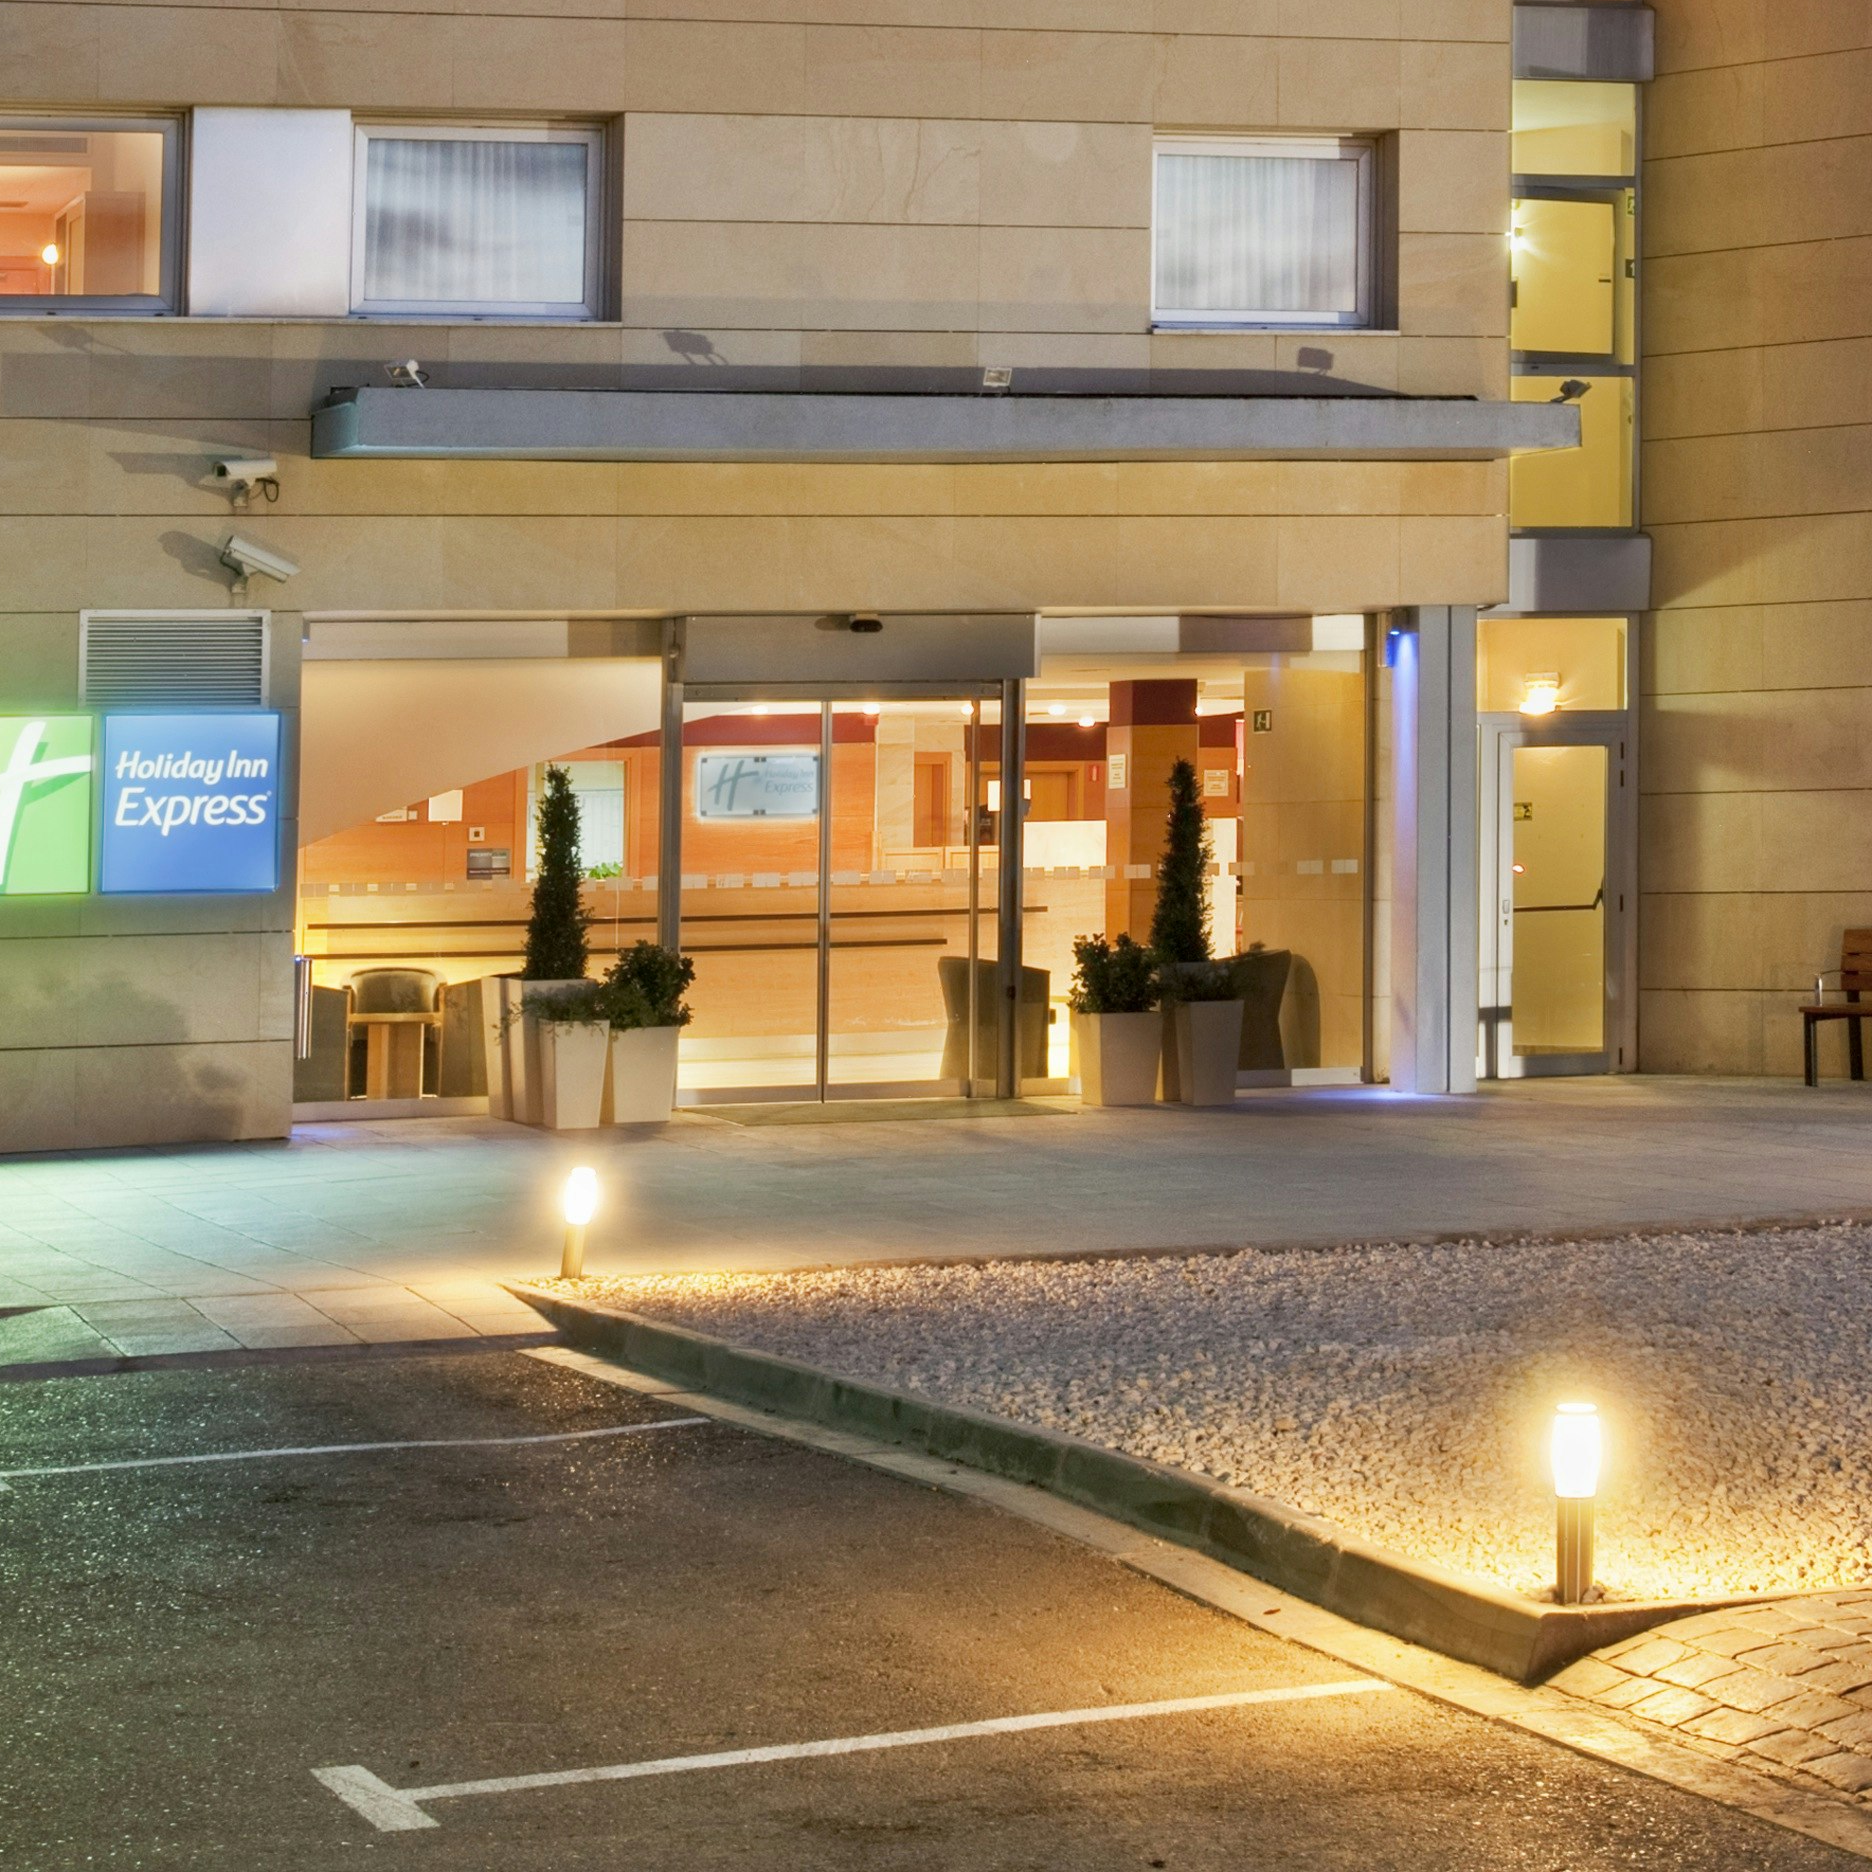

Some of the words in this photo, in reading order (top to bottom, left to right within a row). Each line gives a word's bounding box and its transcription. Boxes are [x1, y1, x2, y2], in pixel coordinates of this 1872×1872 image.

[115, 750, 224, 785] Holiday
[226, 749, 269, 778] Inn
[765, 780, 814, 796] Express
[114, 786, 268, 836] Express
